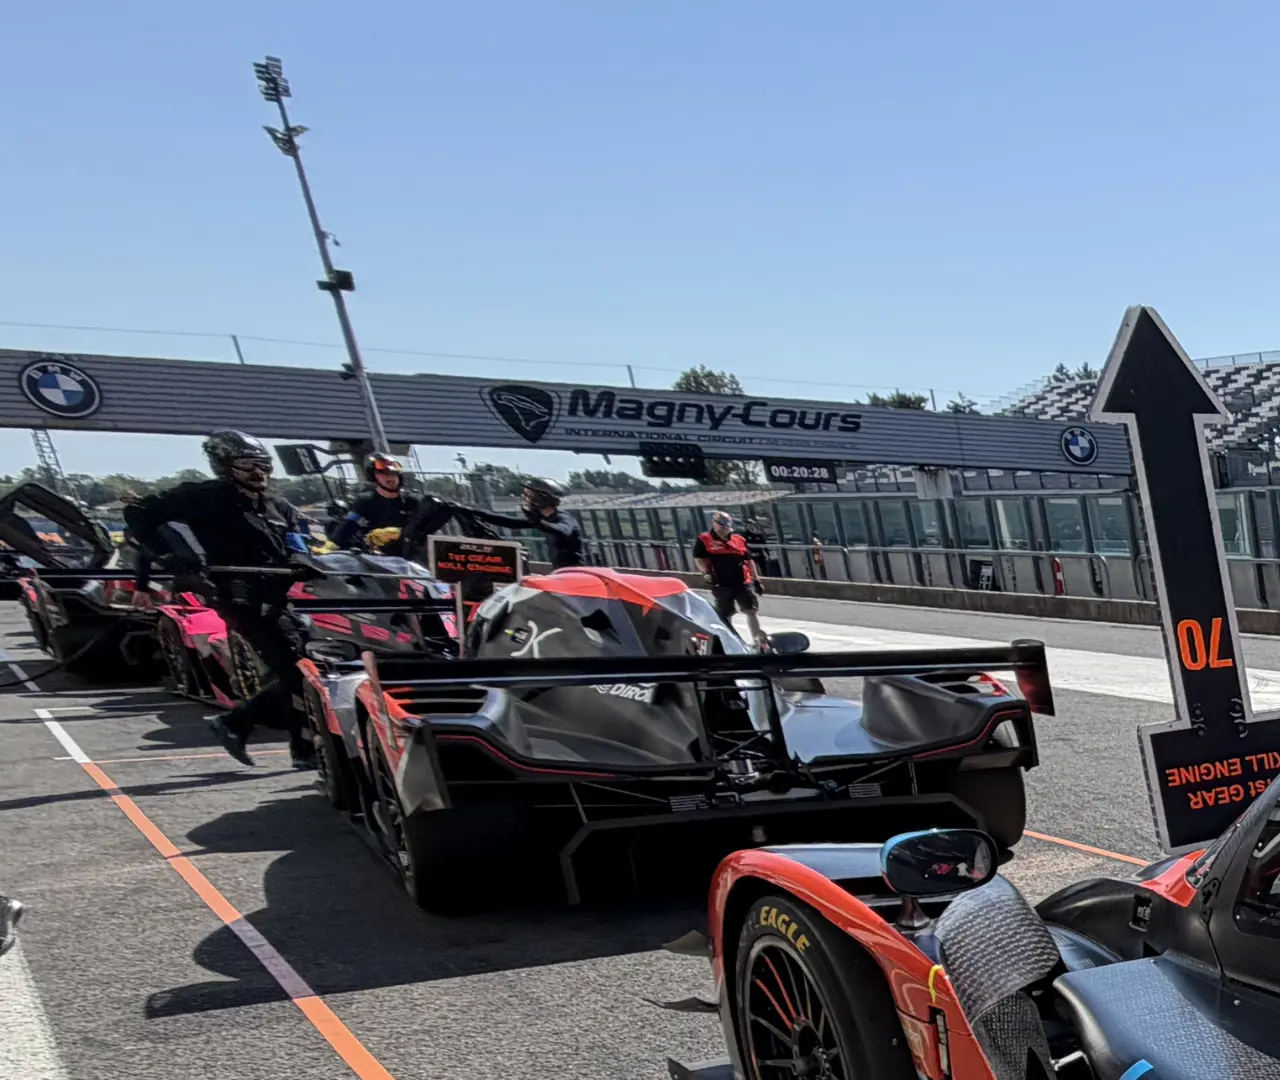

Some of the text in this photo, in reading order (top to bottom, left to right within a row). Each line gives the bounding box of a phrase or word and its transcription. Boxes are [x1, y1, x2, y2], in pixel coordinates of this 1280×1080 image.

[567, 388, 863, 432] Magny-Cours
[564, 427, 691, 442] INTERNATIONAL
[697, 435, 755, 445] CIRCUIT
[770, 465, 830, 480] 00:20:28
[1177, 617, 1234, 671] 70
[1165, 758, 1243, 787] ENGINE
[1187, 783, 1245, 810] GEAR
[760, 905, 810, 956] EAGLE
